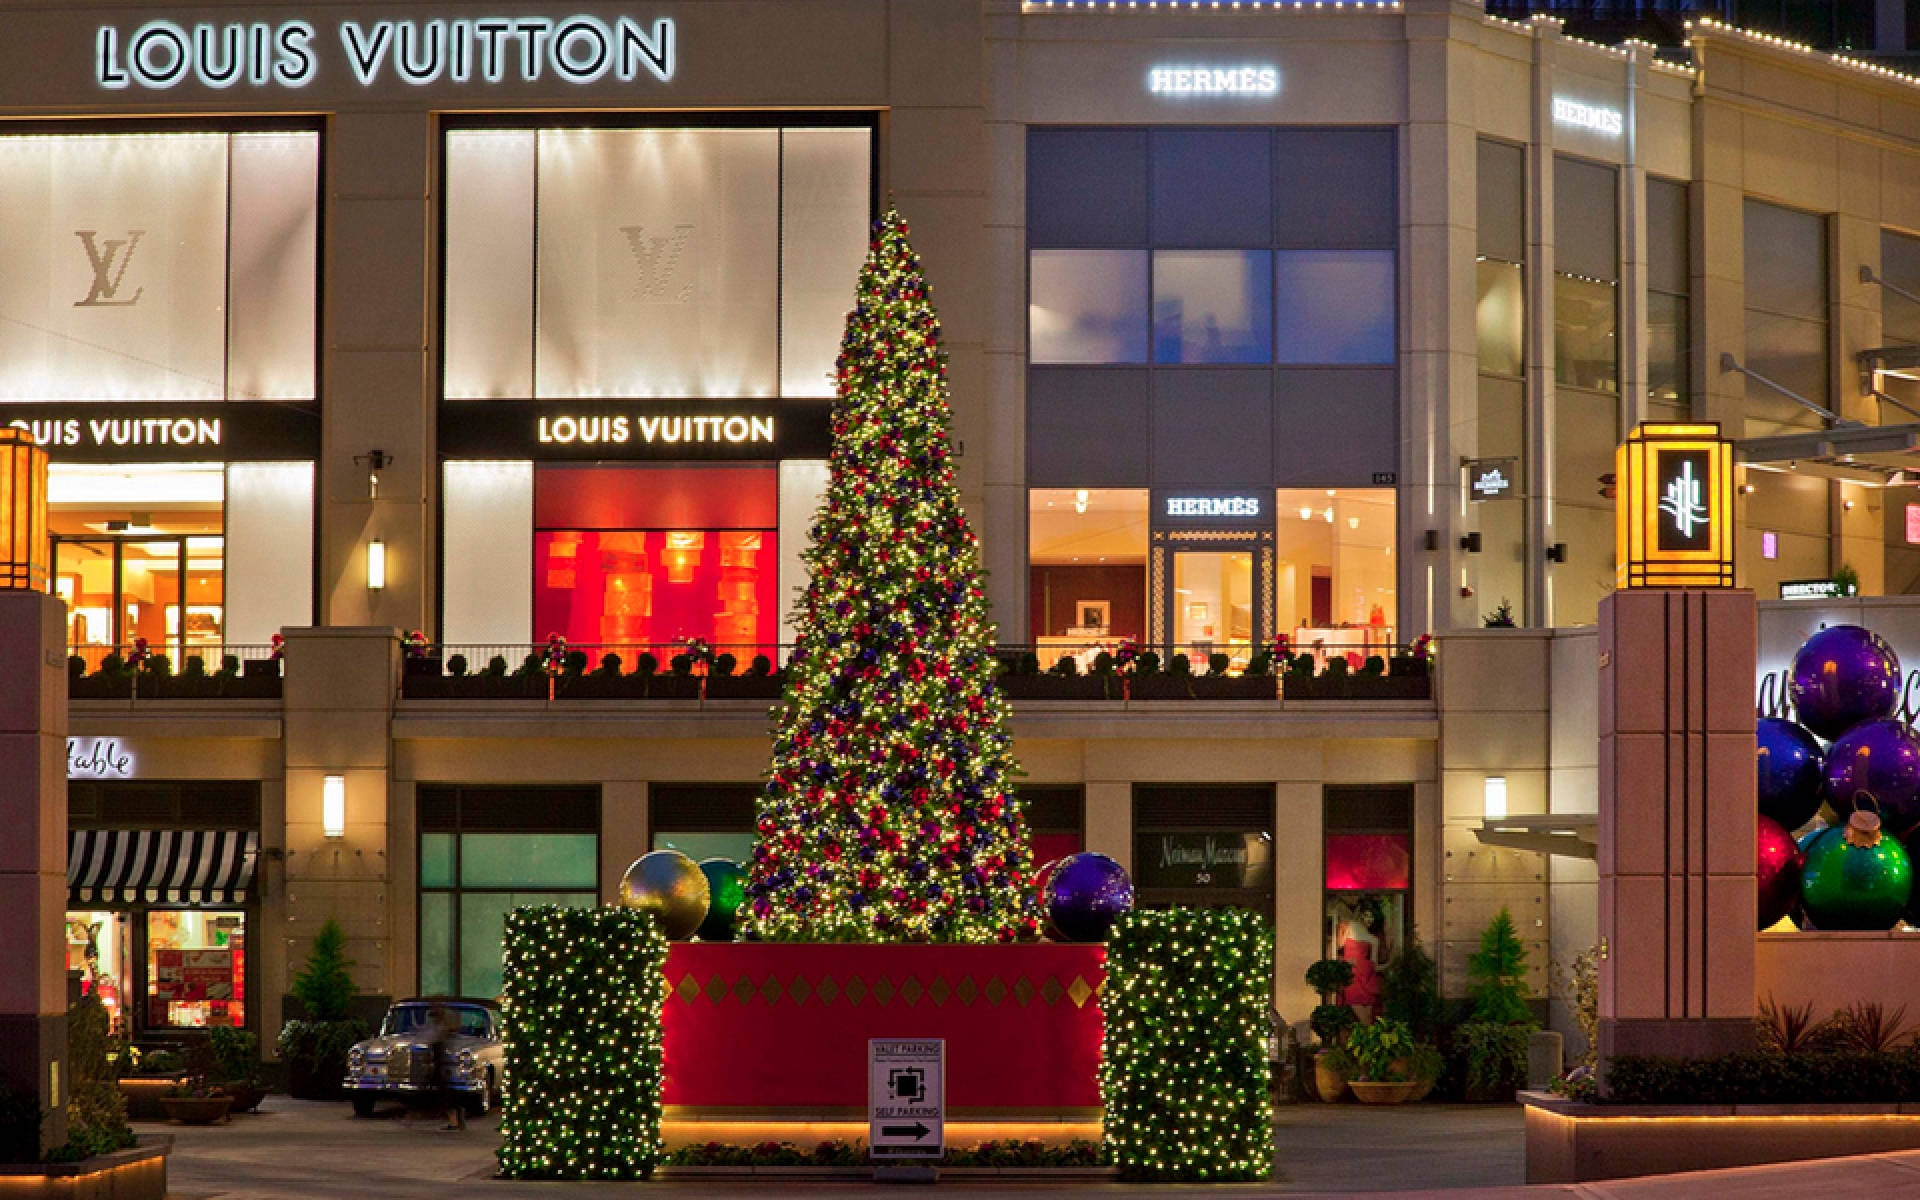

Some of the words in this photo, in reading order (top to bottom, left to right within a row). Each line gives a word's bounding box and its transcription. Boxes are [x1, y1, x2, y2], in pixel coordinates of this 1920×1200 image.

[99, 24, 312, 84] LOUIS
[343, 20, 670, 81] VUITTON
[1151, 67, 1276, 92] HERMÈS
[8, 418, 80, 446] UIS
[89, 418, 221, 446] VUITTON
[537, 415, 630, 443] LOUIS
[638, 415, 775, 443] VUITTON
[1166, 496, 1260, 516] HERMÈS
[1781, 583, 1842, 597] DIRECTOR
[875, 1043, 898, 1056] VALET
[901, 1043, 940, 1056] PARKING
[875, 1107, 895, 1118] SELF
[897, 1107, 939, 1118] PARKING
